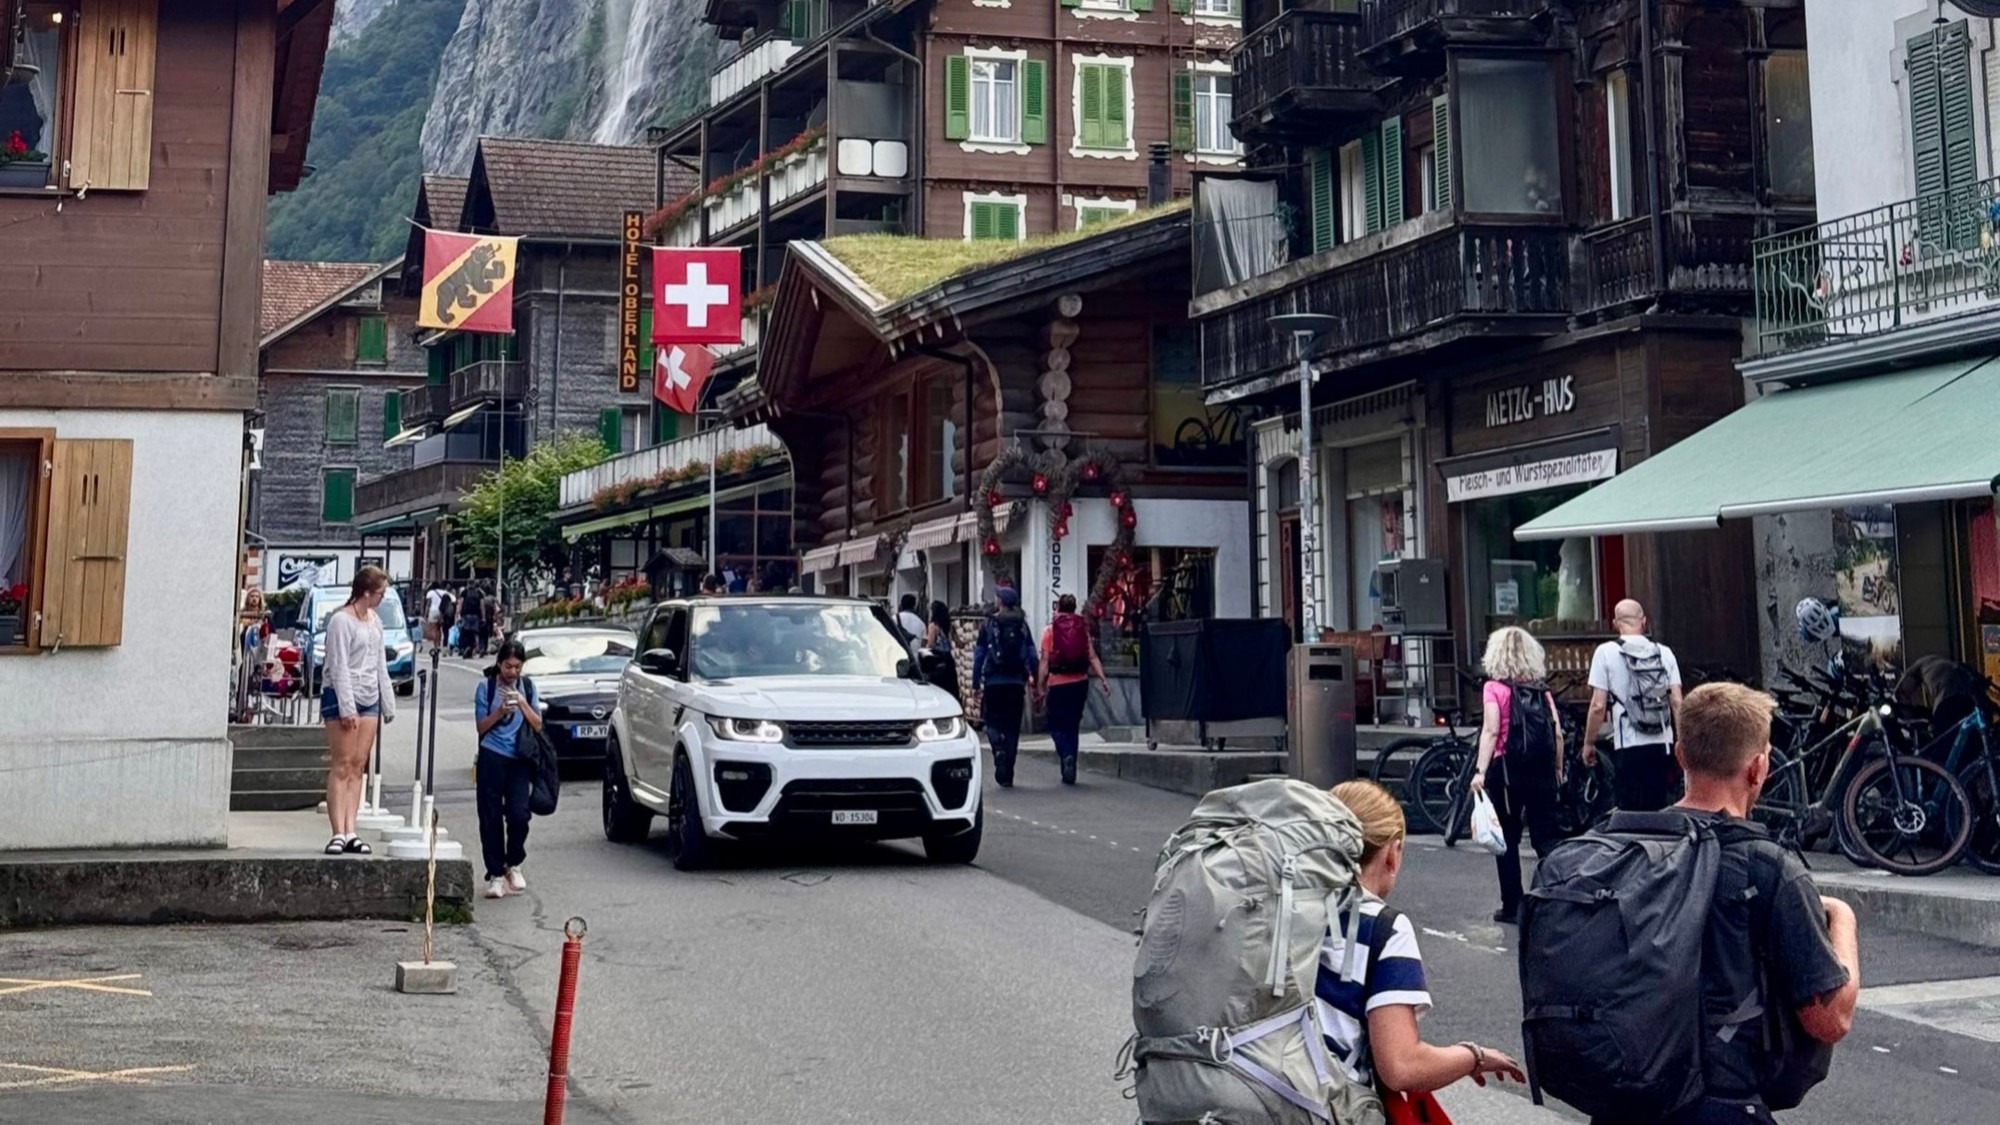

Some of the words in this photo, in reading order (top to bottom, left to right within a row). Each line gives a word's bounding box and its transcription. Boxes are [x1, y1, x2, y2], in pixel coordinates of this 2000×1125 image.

[626, 214, 640, 278] HOTEL
[623, 284, 639, 388] OBERLAND
[1486, 375, 1574, 427] METZG-HUS
[1495, 469, 1512, 487] und
